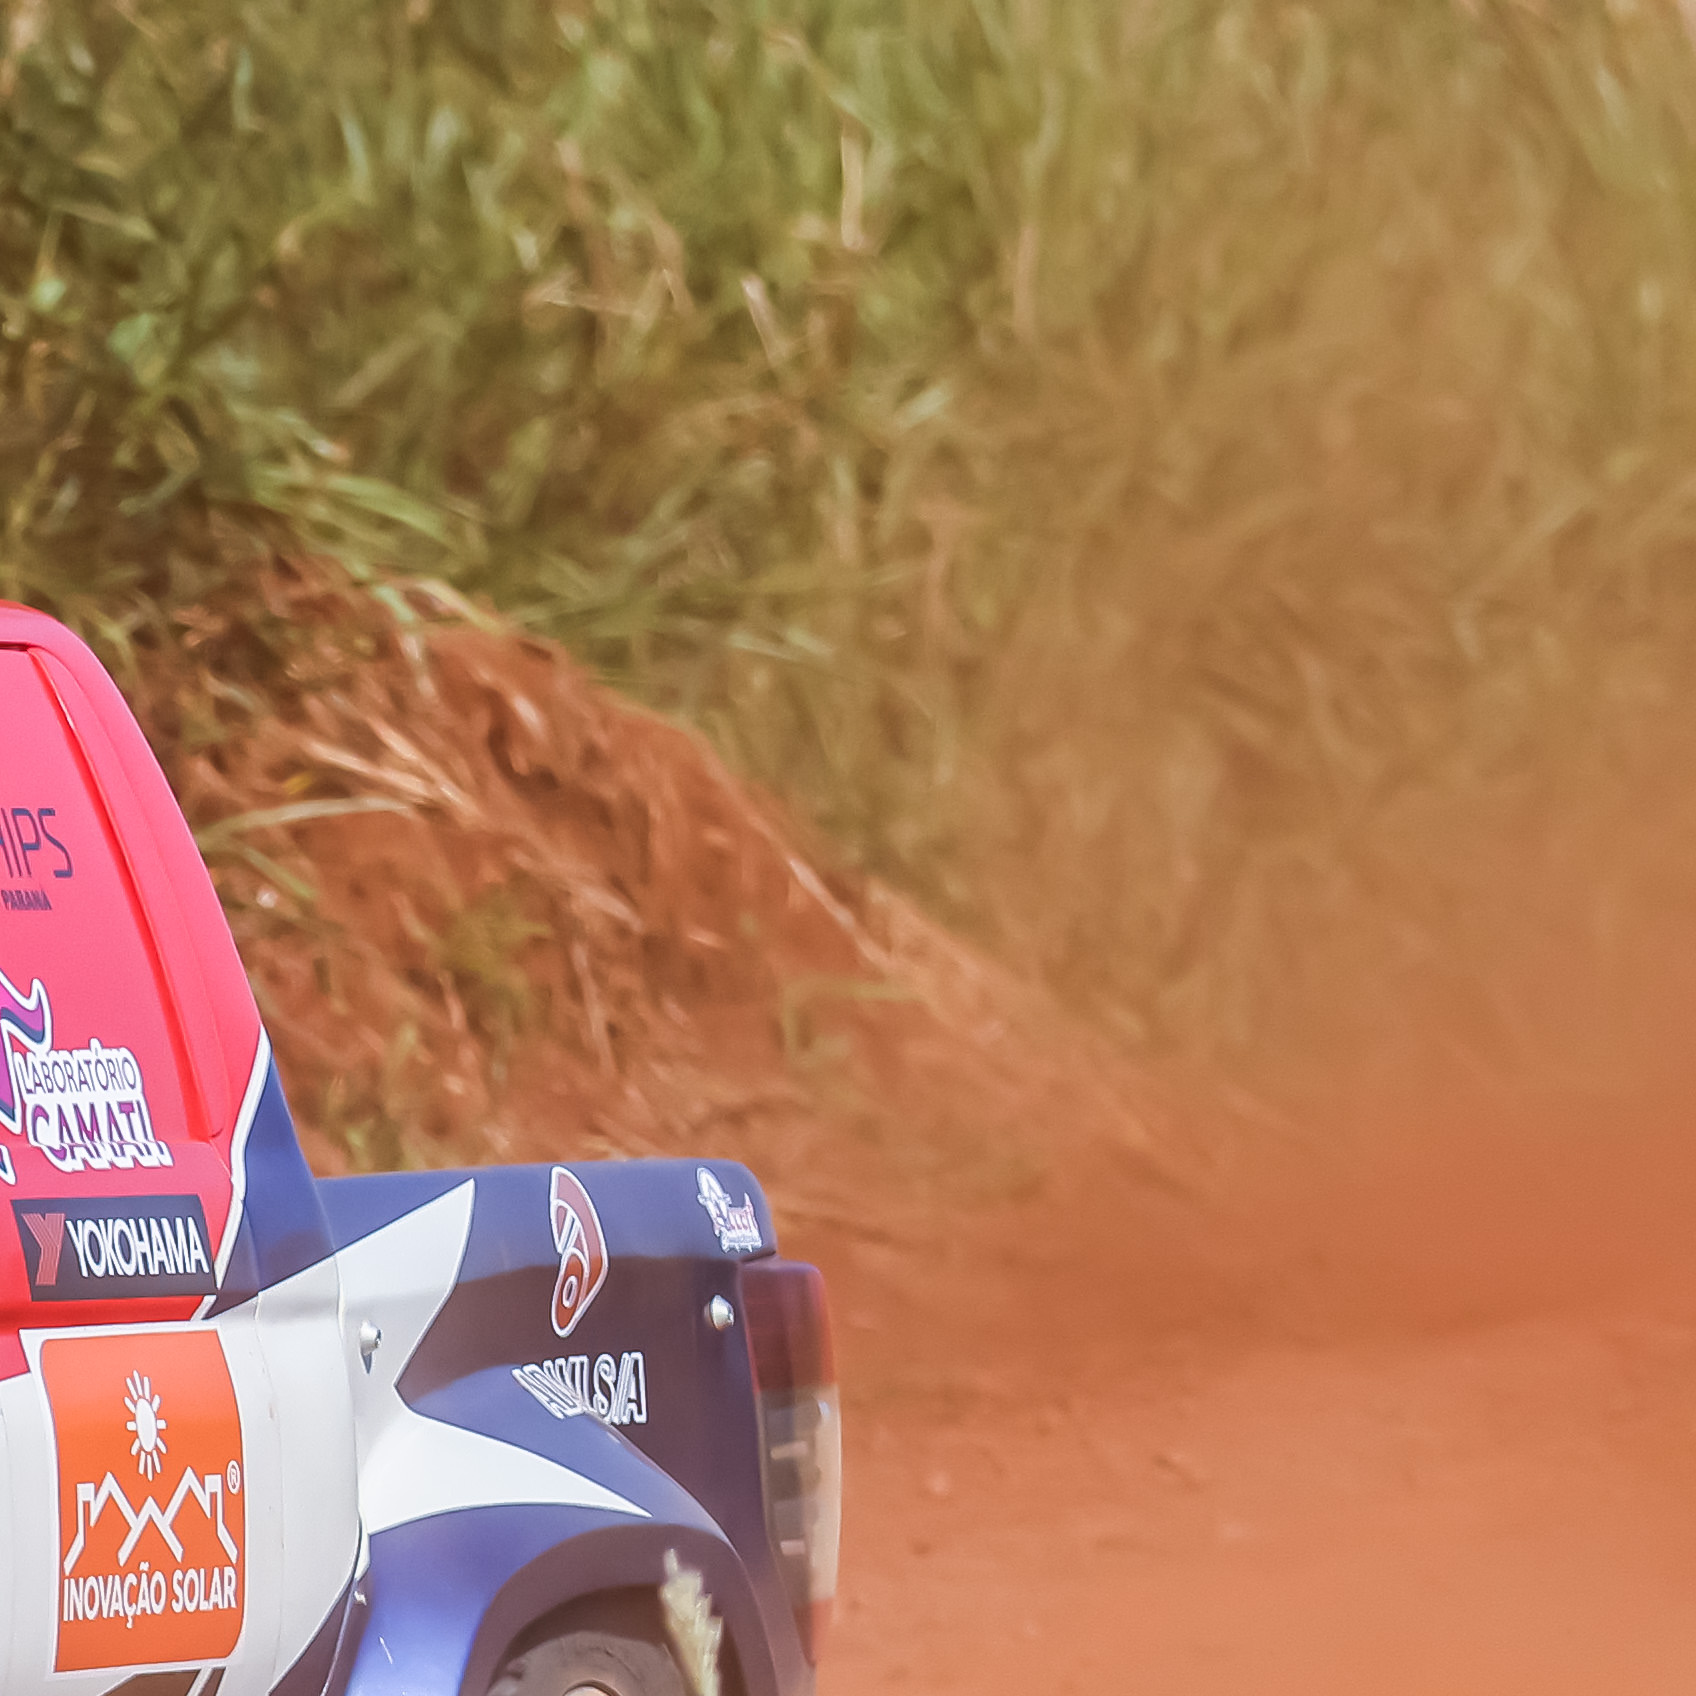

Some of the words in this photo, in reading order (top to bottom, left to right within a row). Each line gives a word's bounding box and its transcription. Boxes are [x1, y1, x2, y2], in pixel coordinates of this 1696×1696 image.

[19, 1049, 137, 1094] LABORATÓRIO
[66, 1216, 210, 1279] YOKOHAMA
[63, 1560, 167, 1629] INOVAÇÃO
[171, 1566, 238, 1613] SOLAR
